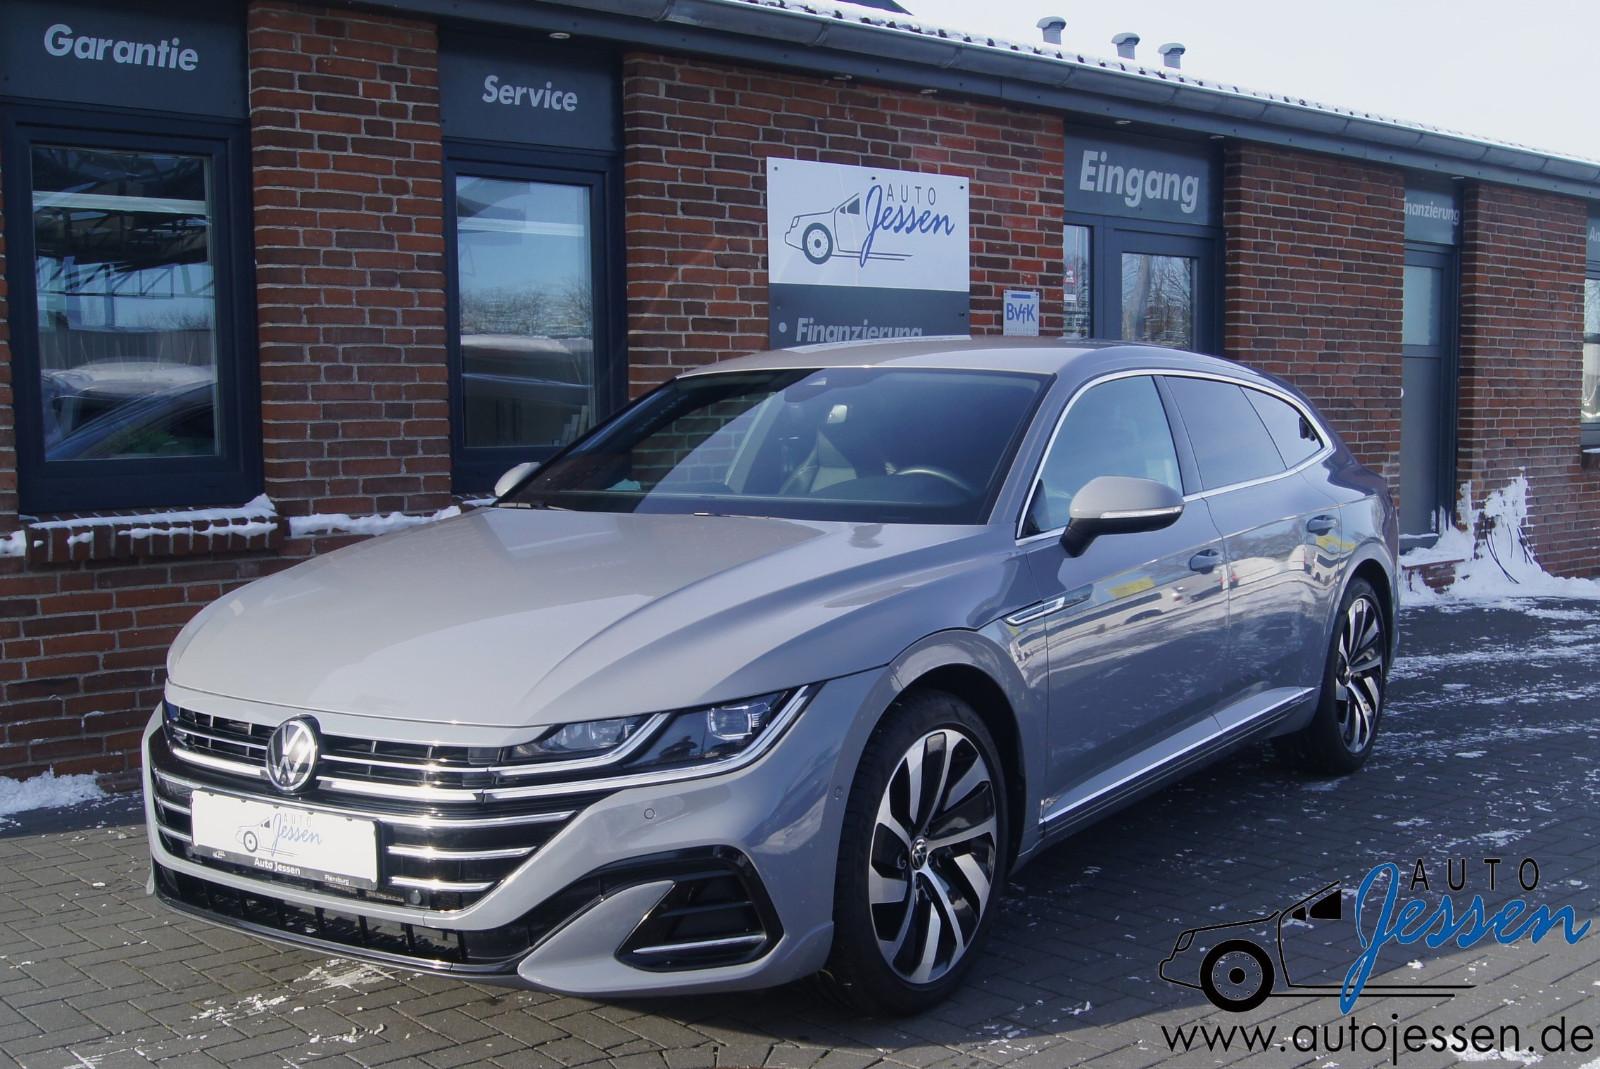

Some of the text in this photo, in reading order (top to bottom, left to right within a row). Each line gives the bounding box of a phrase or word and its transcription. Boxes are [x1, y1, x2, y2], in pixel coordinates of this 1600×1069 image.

[44, 24, 199, 72] Garantie
[482, 75, 578, 112] Service
[886, 183, 936, 206] AUTO
[1080, 150, 1199, 214] Eingang
[860, 185, 955, 268] Jessen
[271, 813, 322, 857] Jessen
[284, 813, 312, 828] AUTO
[254, 858, 301, 876] Auto Jessen
